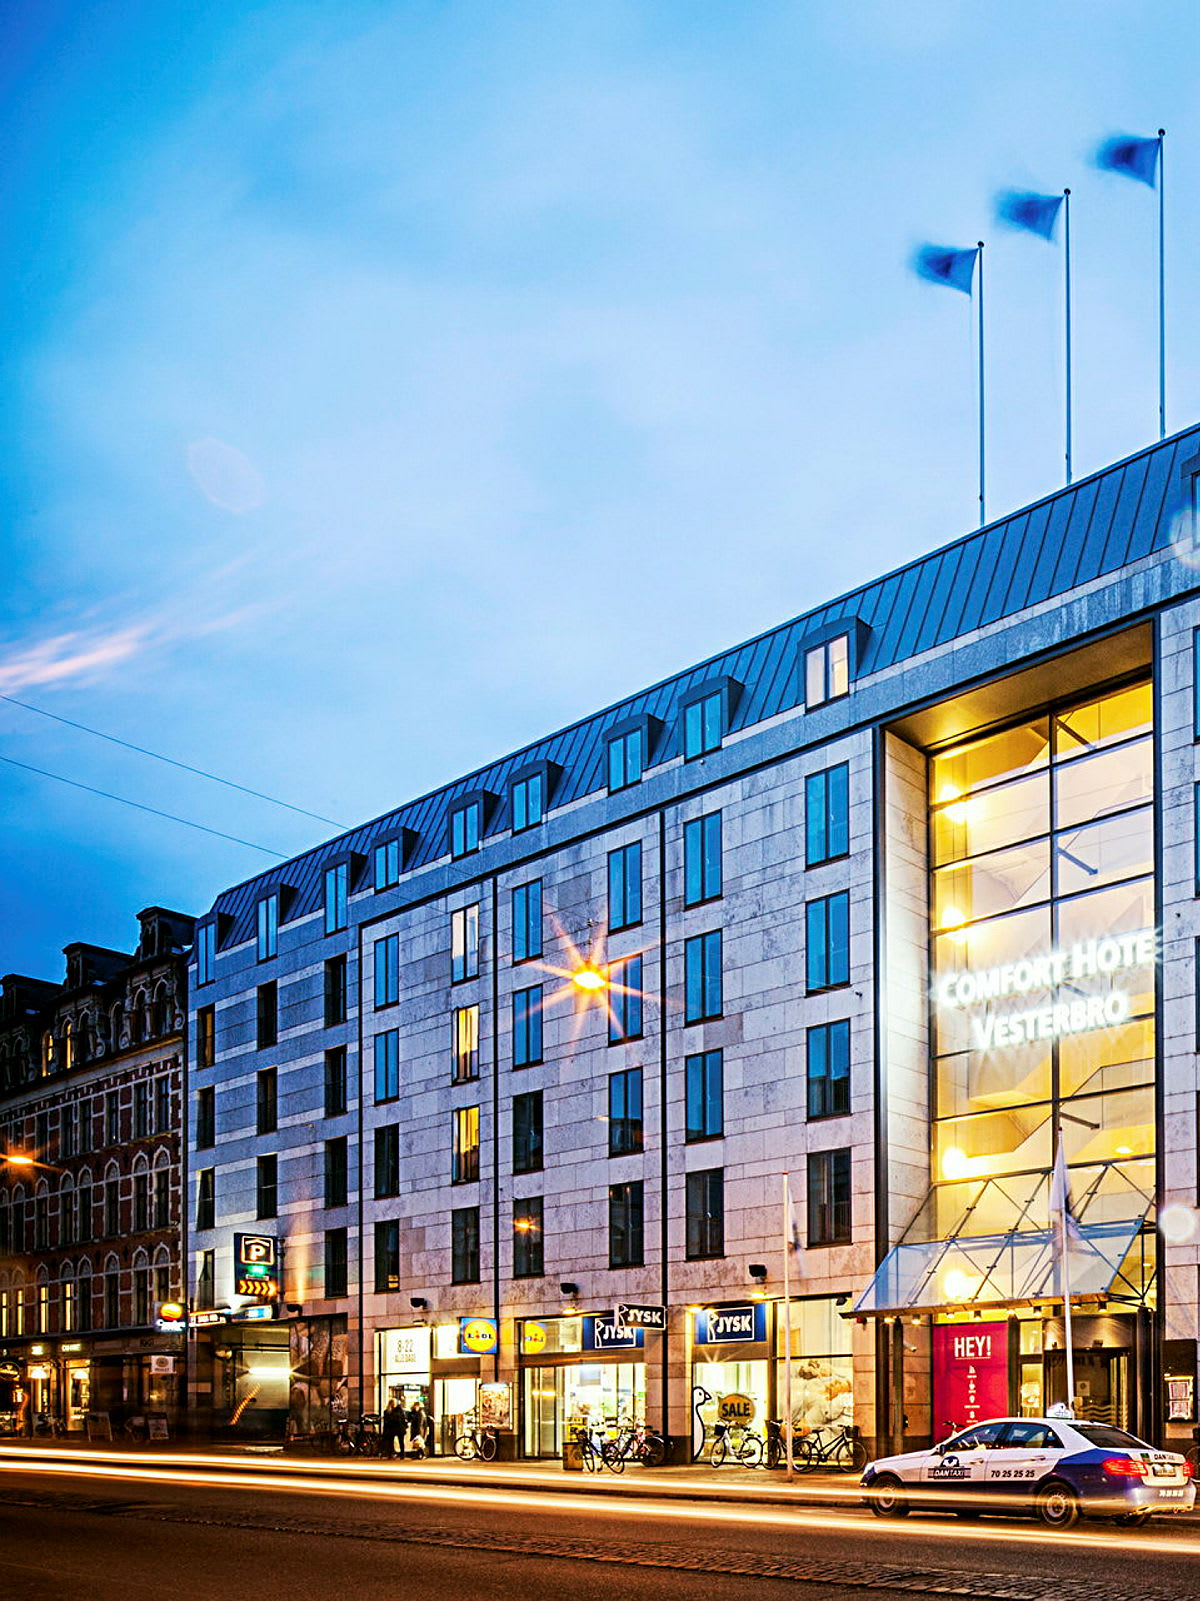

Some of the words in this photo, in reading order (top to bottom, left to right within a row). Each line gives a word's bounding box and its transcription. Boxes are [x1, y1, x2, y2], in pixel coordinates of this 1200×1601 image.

[938, 953, 1068, 1006] COMFORT
[1071, 933, 1156, 979] HOTE
[974, 992, 1129, 1049] VESTERBRO
[627, 1309, 662, 1324] JYSK
[716, 1314, 752, 1334] JYSK
[954, 1335, 992, 1357] HEY!
[721, 1402, 751, 1417] SALE
[991, 1470, 1000, 1478] 70
[1002, 1470, 1012, 1478] 25
[1013, 1470, 1024, 1478] 25
[1025, 1469, 1035, 1478] 25
